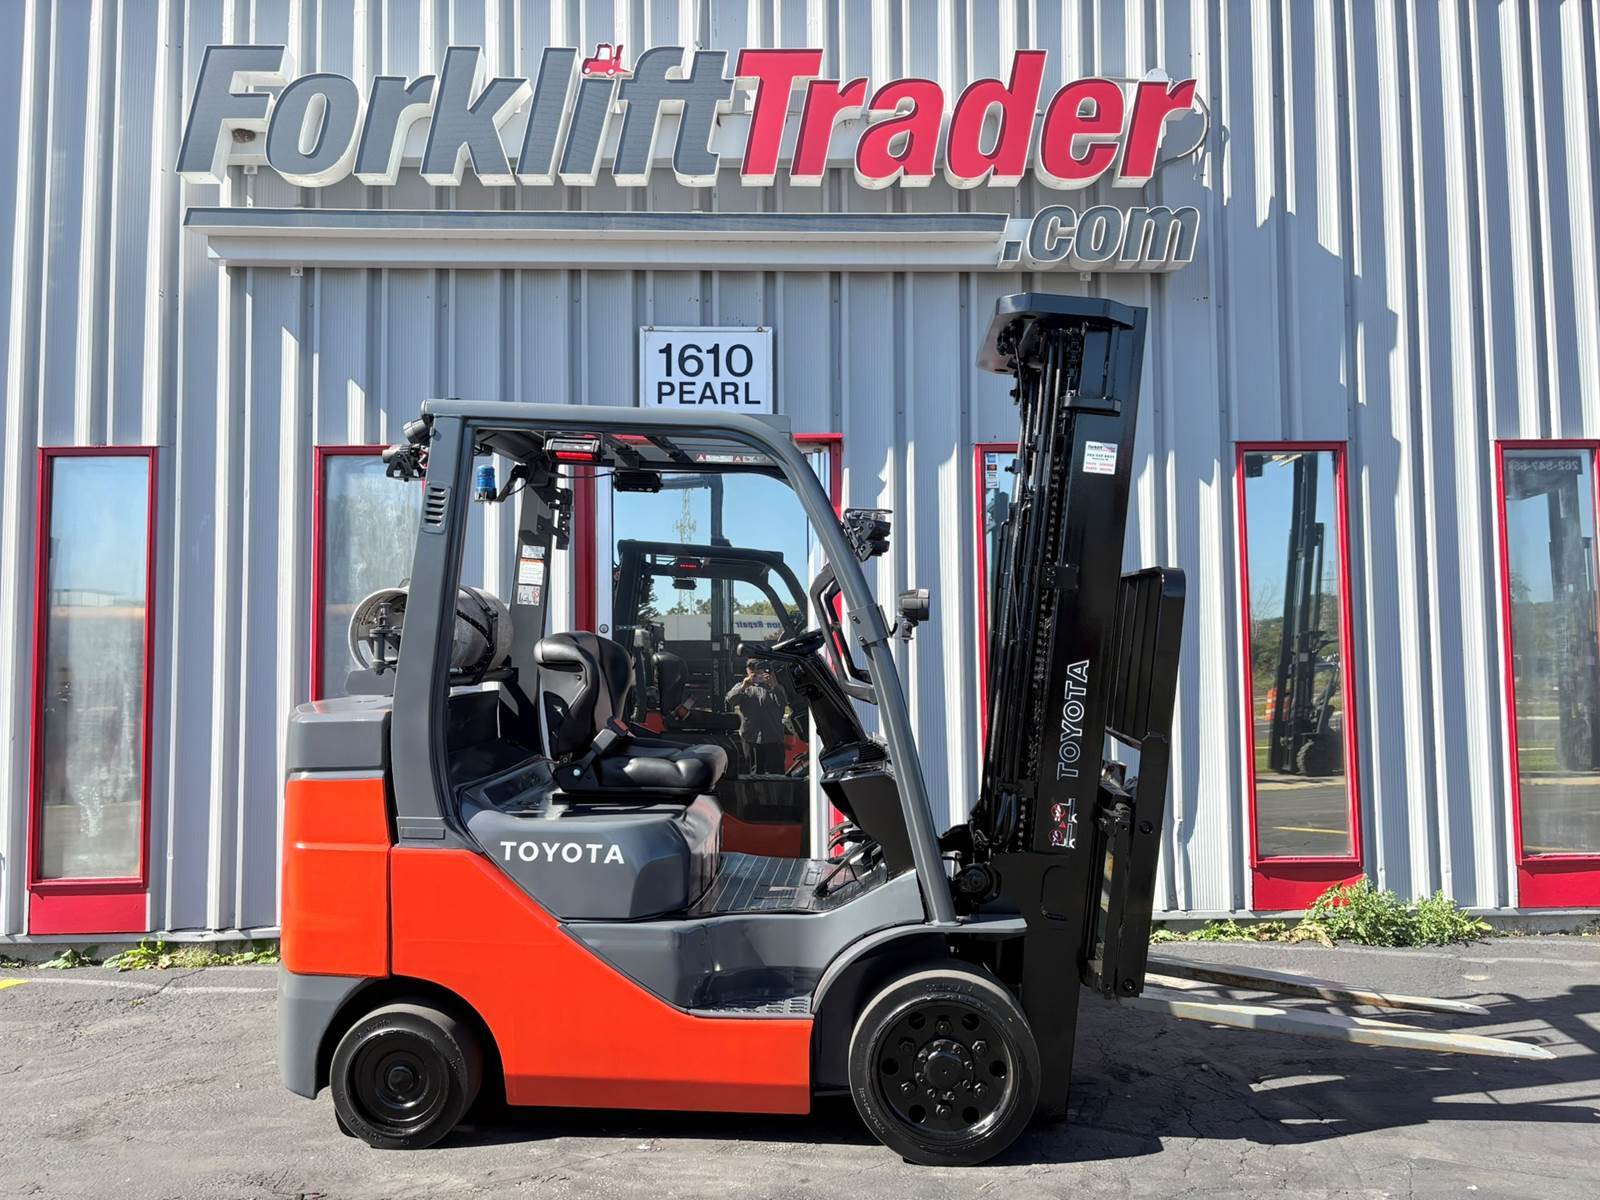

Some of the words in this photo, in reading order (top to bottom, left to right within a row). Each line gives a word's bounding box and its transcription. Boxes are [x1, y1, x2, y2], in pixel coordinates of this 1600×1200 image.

[1000, 204, 1201, 267] .com
[658, 343, 753, 377] 1610
[657, 381, 761, 404] PEARL
[1056, 659, 1090, 780] TOYOTA
[500, 841, 625, 864] TOYOTA
